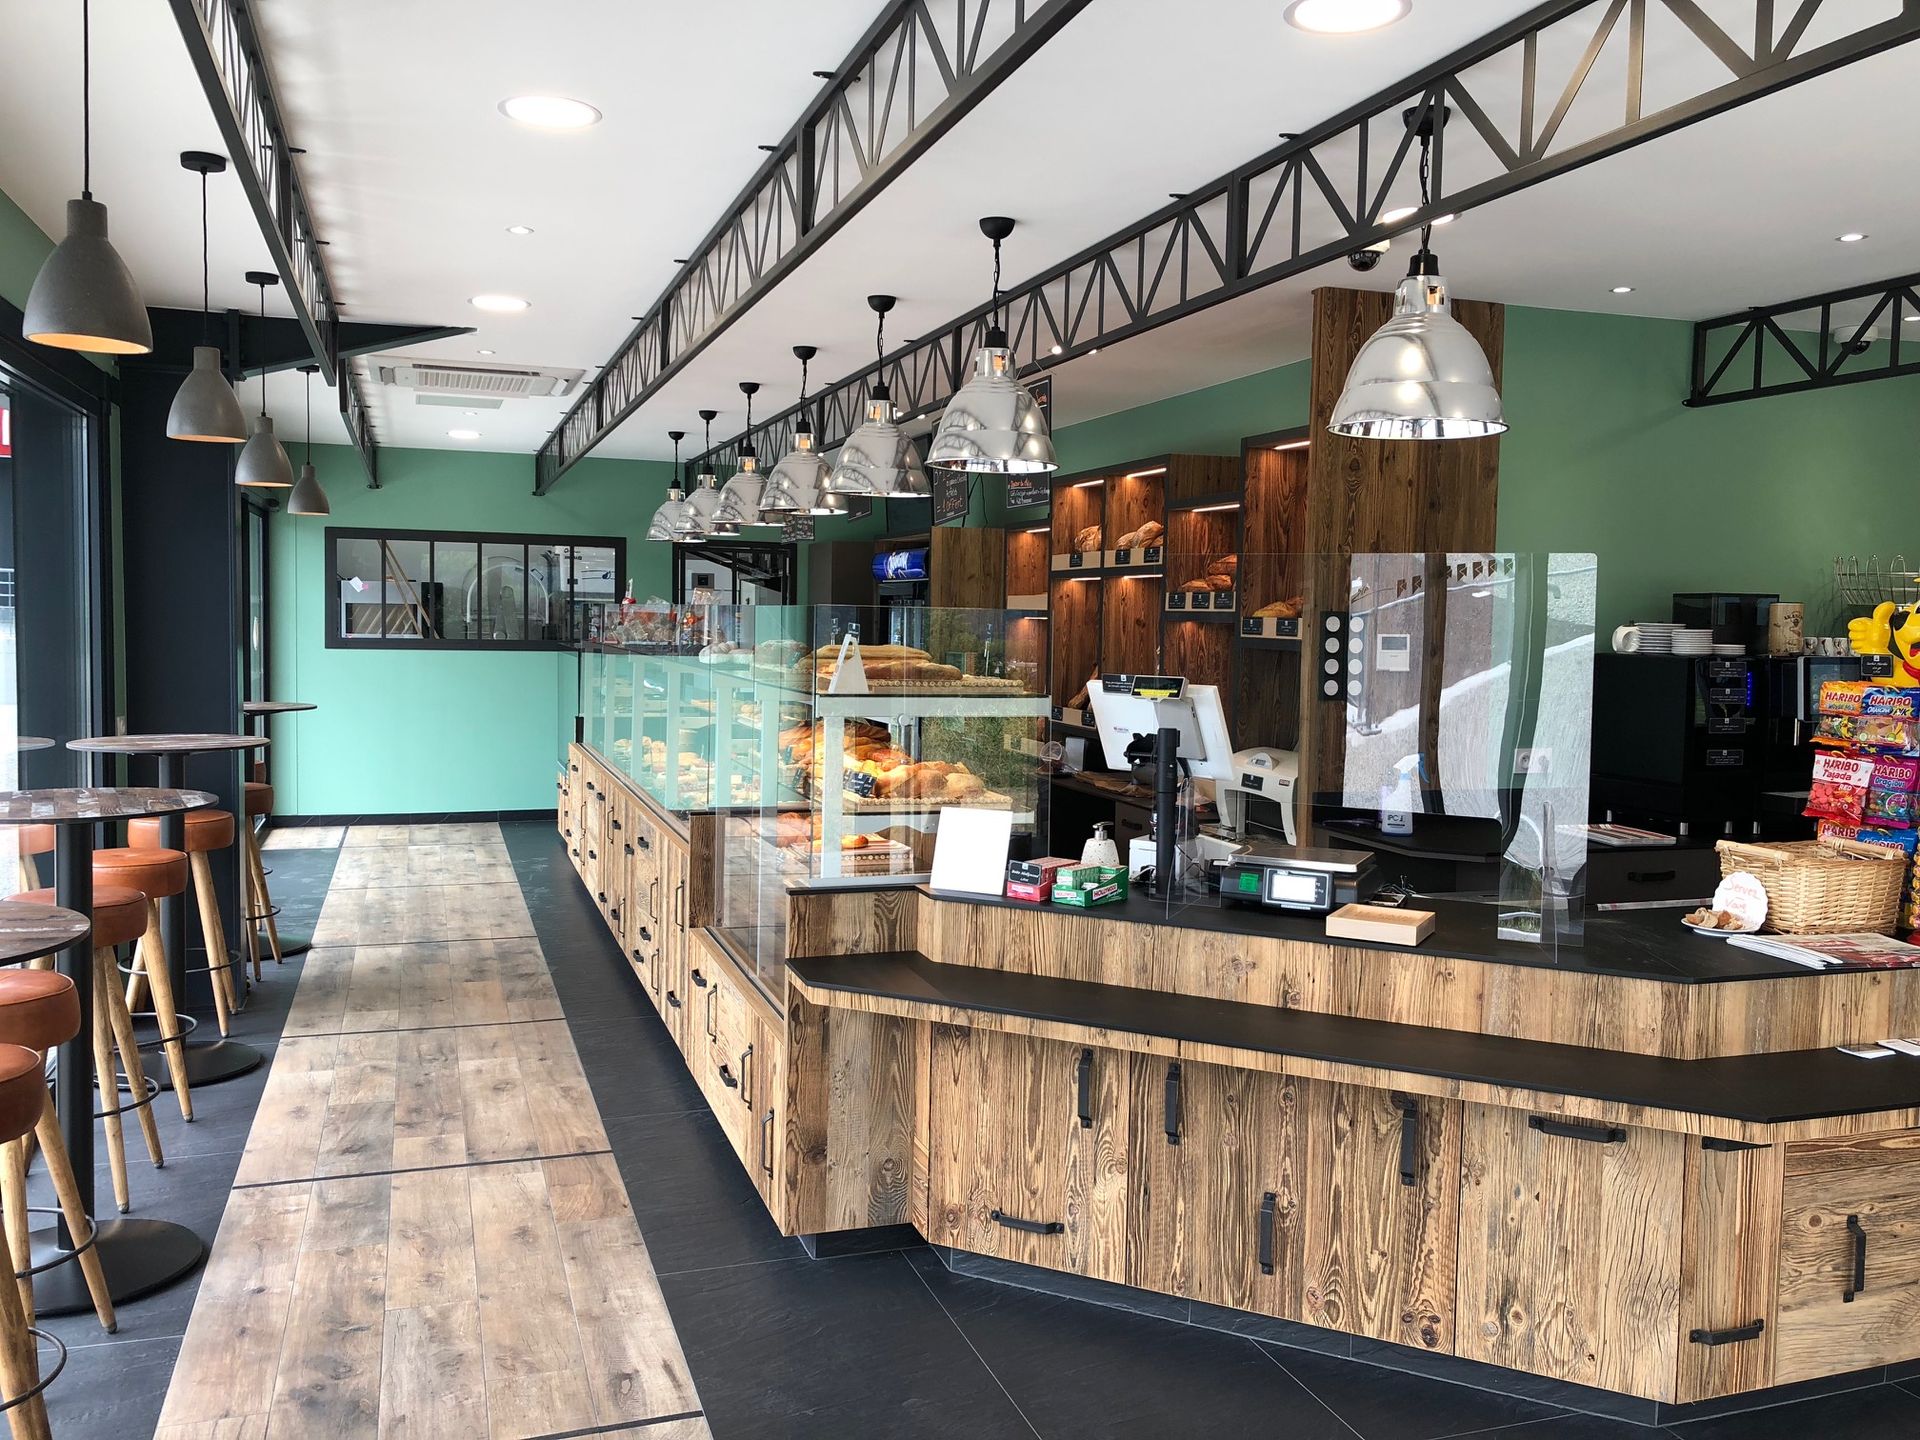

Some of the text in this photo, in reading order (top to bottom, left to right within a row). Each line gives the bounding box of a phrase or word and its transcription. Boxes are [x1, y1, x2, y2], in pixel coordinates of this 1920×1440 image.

[1825, 691, 1861, 703] HARIBO
[1869, 696, 1911, 707] HARIBO
[1823, 758, 1860, 773] HARIBO
[1873, 765, 1912, 779] HARIBO
[1093, 884, 1117, 898] HOLLYWOOD
